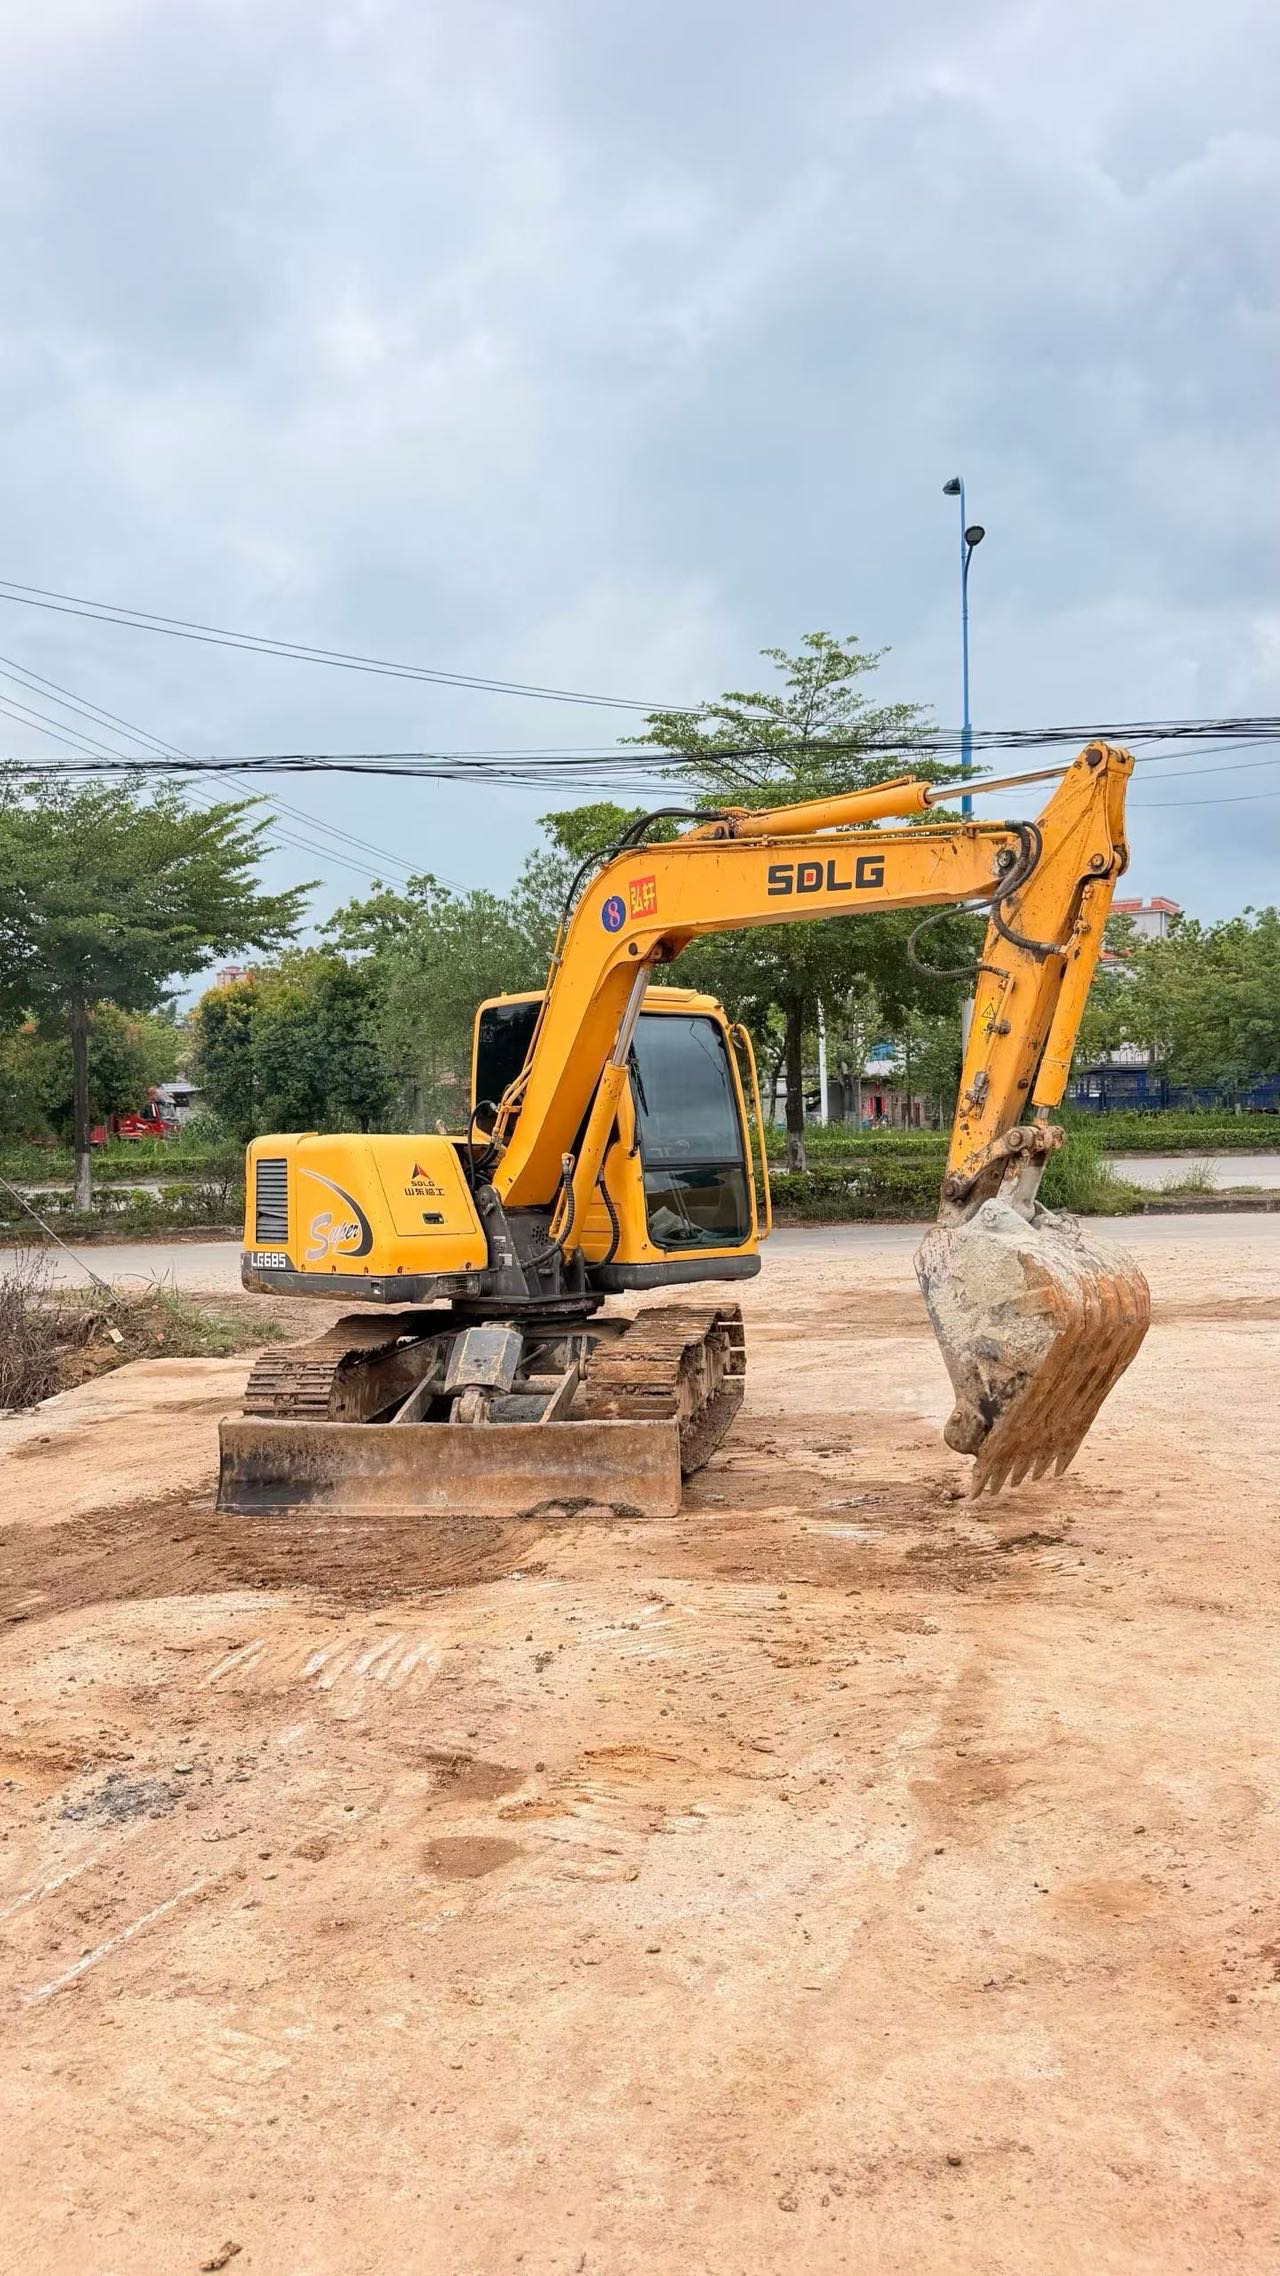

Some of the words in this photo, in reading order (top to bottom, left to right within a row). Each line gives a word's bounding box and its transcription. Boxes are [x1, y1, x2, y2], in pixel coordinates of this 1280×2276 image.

[767, 855, 885, 896] SDLG
[608, 900, 621, 928] 8
[305, 1211, 361, 1261] Super
[251, 1252, 286, 1268] LG685
